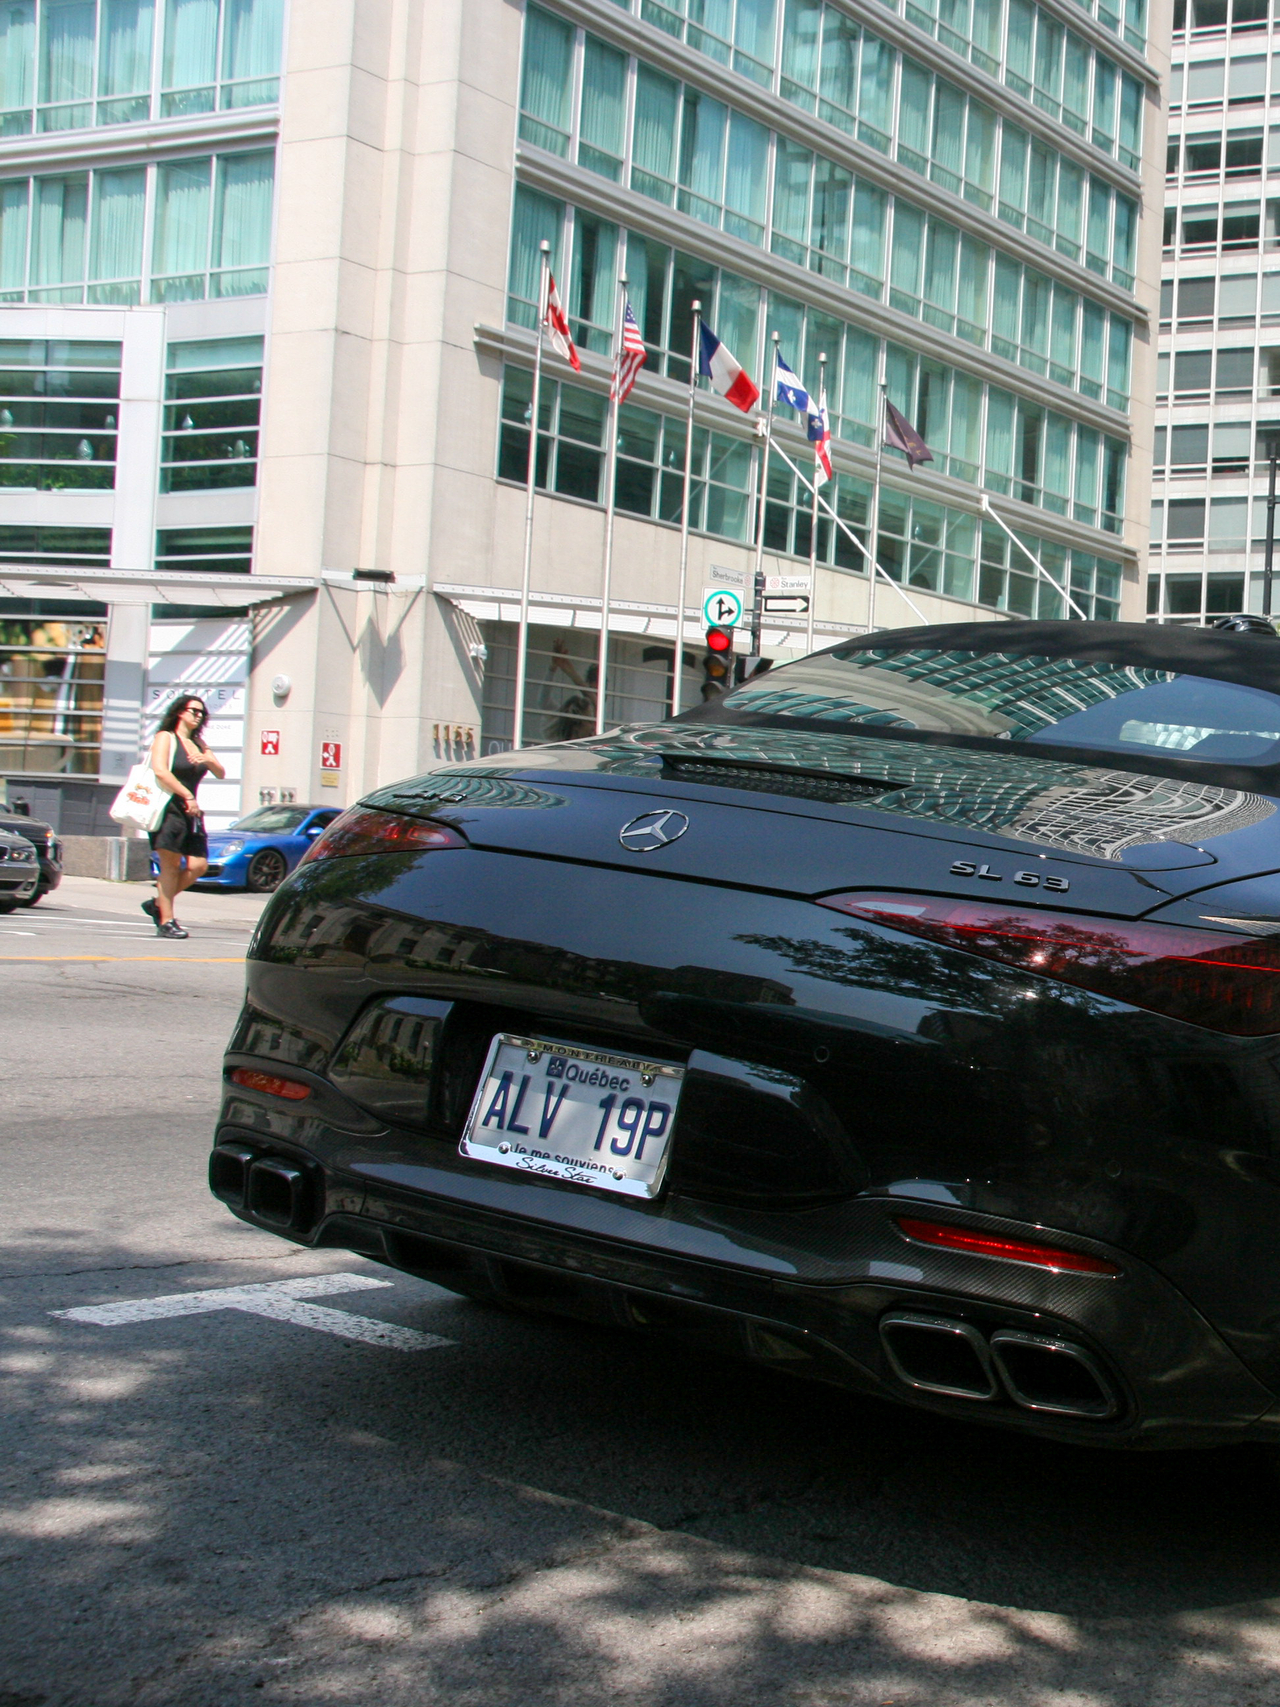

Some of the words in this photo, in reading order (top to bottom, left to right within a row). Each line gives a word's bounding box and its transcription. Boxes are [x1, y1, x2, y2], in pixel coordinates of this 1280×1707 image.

[712, 570, 744, 585] Sherbrooke
[780, 580, 808, 589] Stanley
[432, 724, 474, 743] 1155
[950, 860, 1002, 882] SL
[1014, 870, 1070, 893] 63
[565, 1063, 631, 1092] Québec
[482, 1070, 571, 1139] ALV
[593, 1093, 672, 1161] 19P
[530, 1149, 551, 1160] me
[515, 1156, 560, 1176] Silver
[562, 1166, 598, 1184] Star
